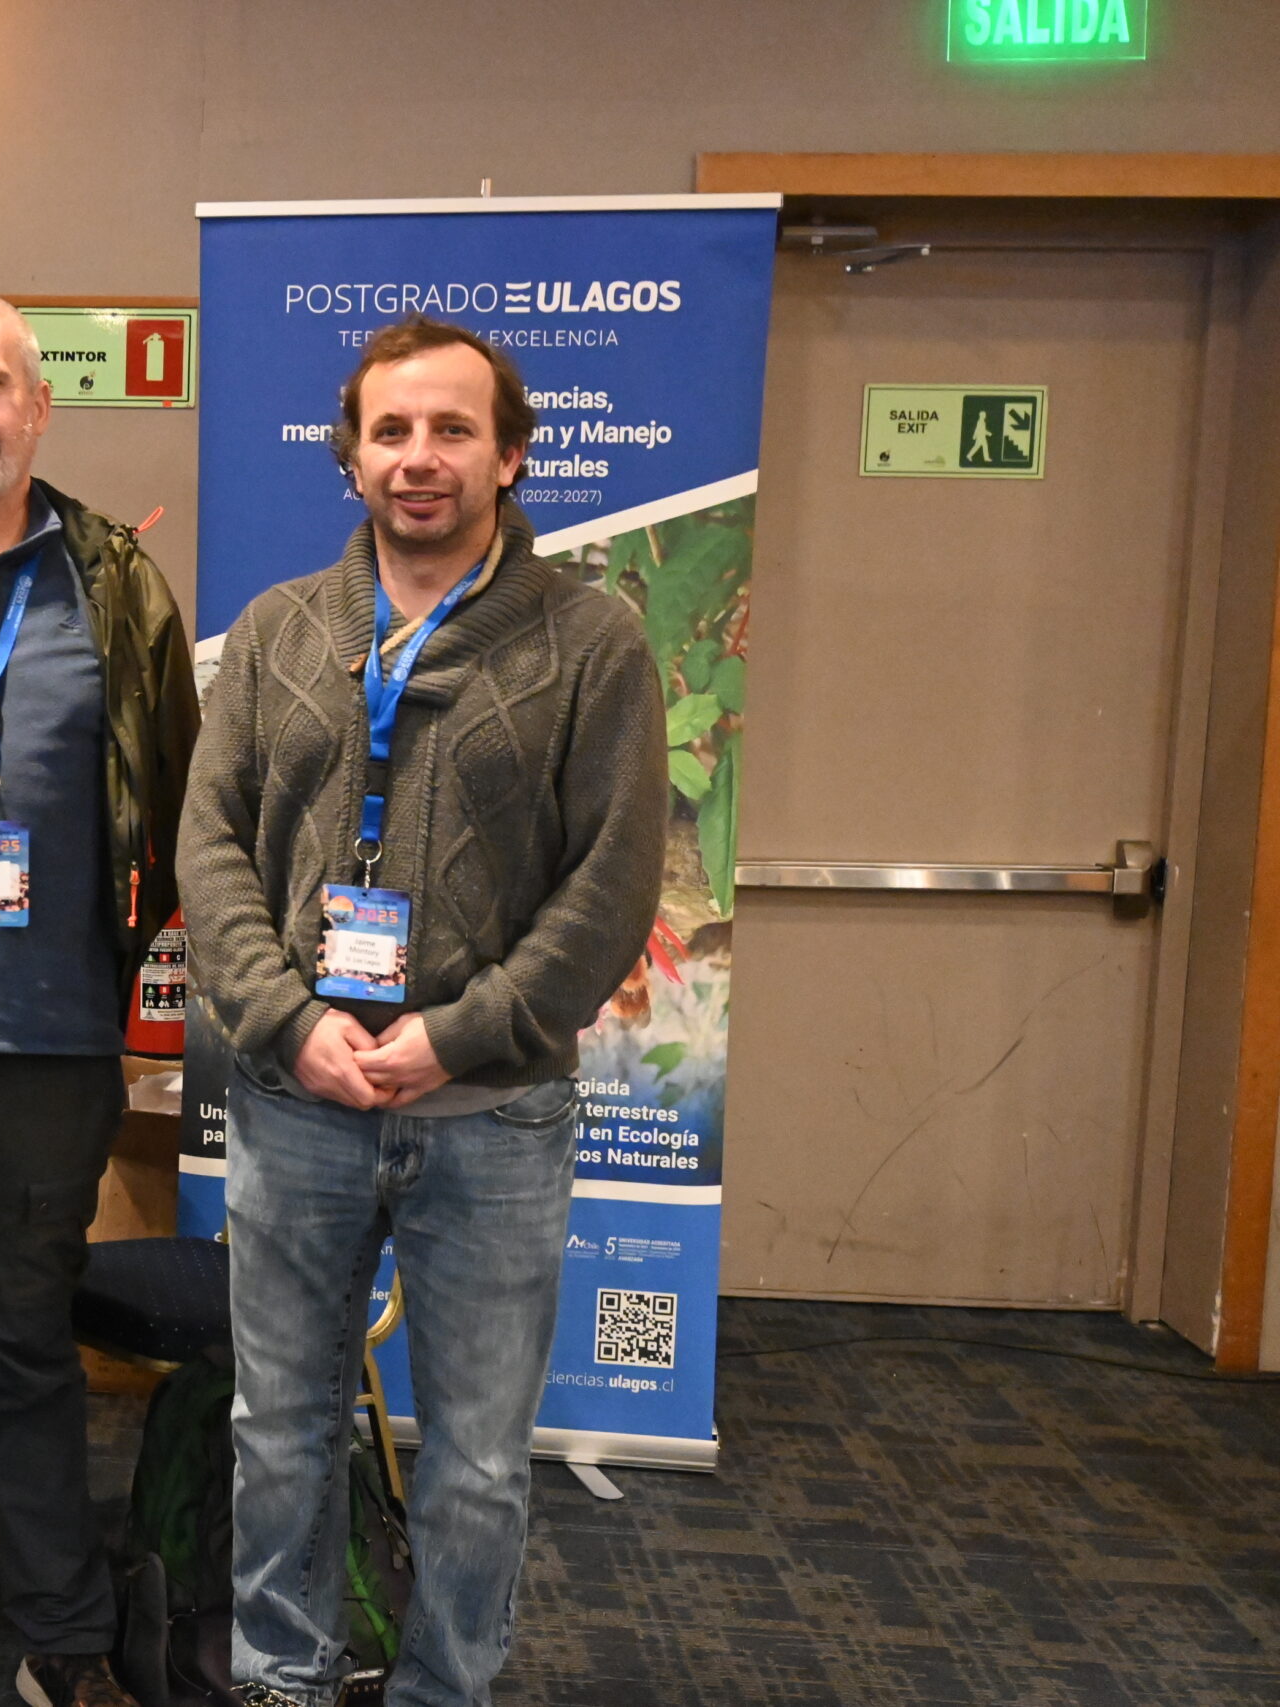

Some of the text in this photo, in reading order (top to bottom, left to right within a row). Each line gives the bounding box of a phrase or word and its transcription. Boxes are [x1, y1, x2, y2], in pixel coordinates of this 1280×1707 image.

[965, 0, 1130, 45] SALIDA
[286, 281, 681, 313] POSTGRADO ULAGOS
[489, 330, 619, 347] EXCELENCIA
[40, 350, 107, 362] XTINTOR
[523, 386, 613, 413] iencias,
[889, 410, 939, 421] SALIDA
[559, 425, 575, 449] y
[580, 420, 672, 449] Manejo
[897, 422, 927, 434] EXIT
[526, 454, 609, 478] turales
[521, 489, 602, 505] (2022-2027)
[356, 908, 399, 923] 2025
[575, 1078, 630, 1097] giada
[585, 1102, 679, 1122] terrestres
[590, 1127, 612, 1141] en
[618, 1126, 699, 1149] Ecología
[607, 1148, 699, 1169] Naturales
[604, 1236, 617, 1255] 5
